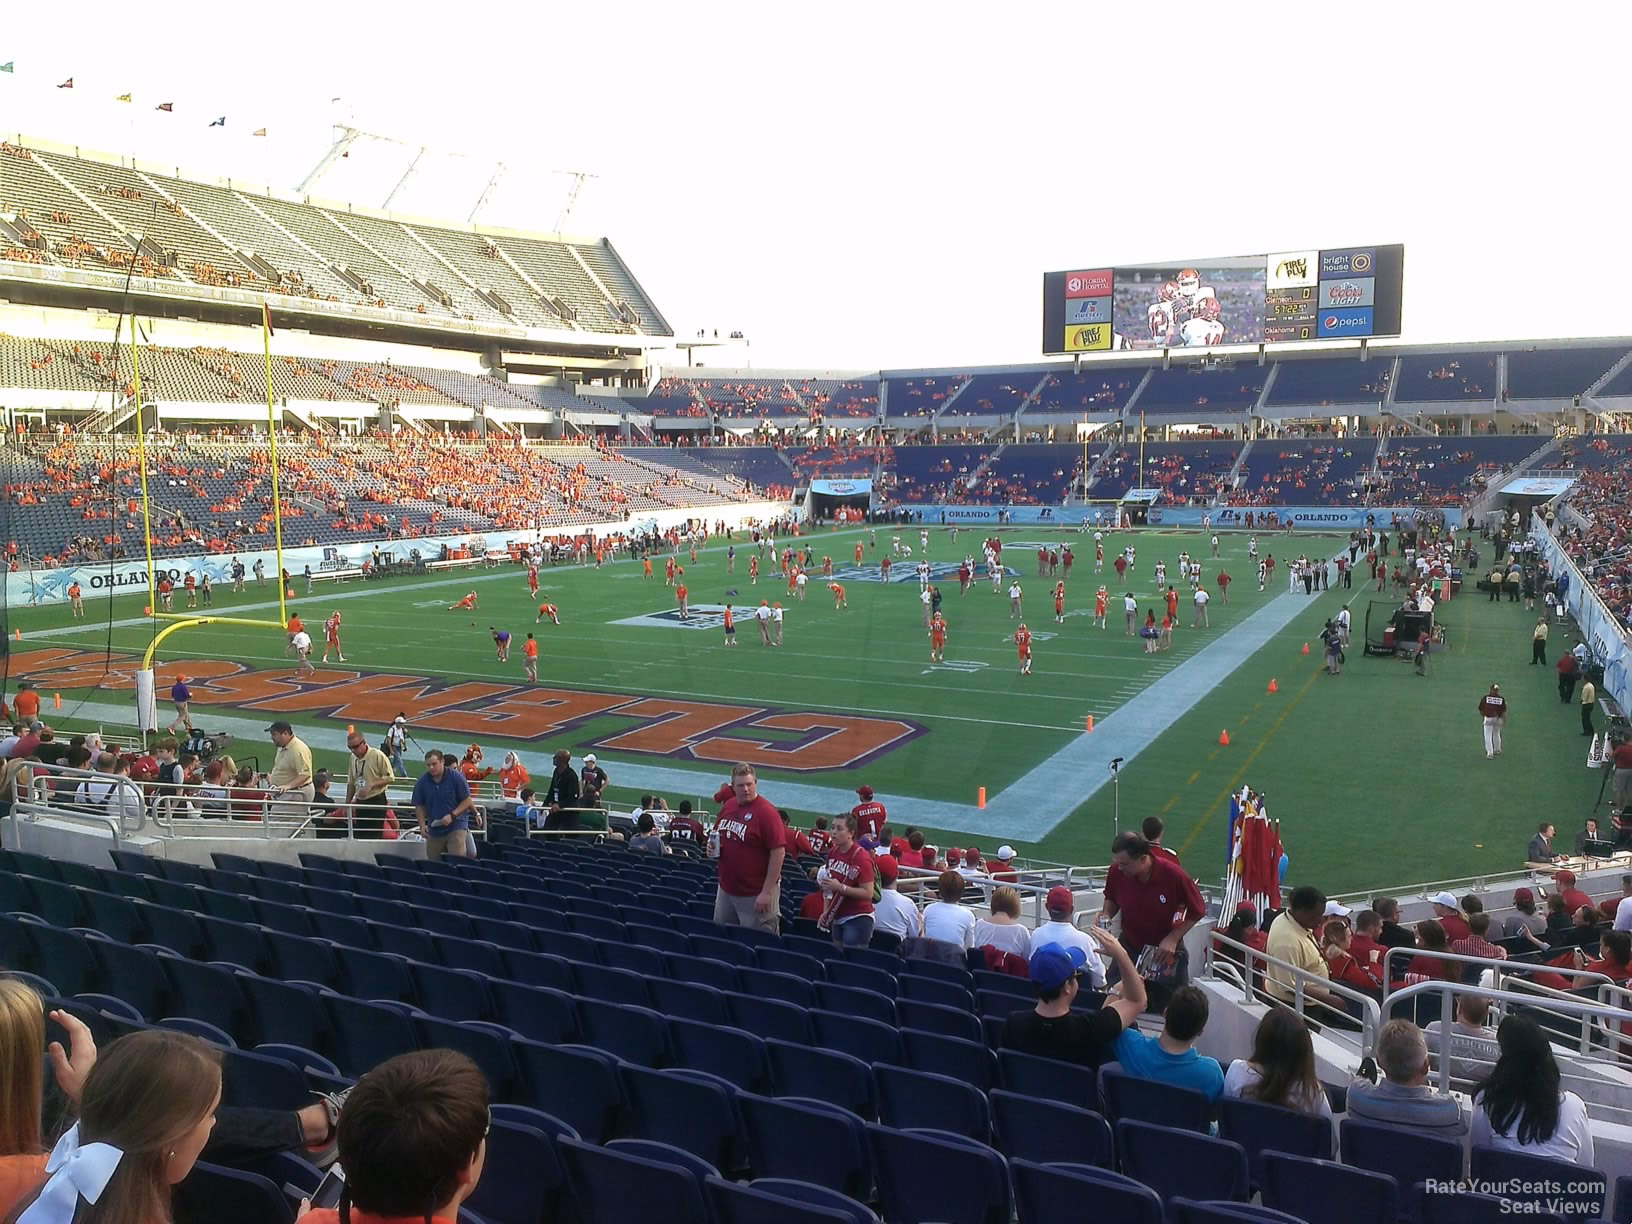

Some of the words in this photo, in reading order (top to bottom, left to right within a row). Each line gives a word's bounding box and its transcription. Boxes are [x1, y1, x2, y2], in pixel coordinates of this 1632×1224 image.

[1323, 256, 1349, 265] bright
[1323, 264, 1349, 273] house
[1330, 296, 1361, 305] LIGHT
[1339, 316, 1366, 327] pepsi
[1264, 327, 1295, 335] Oklahoma
[1294, 513, 1348, 521] ORLANDO
[869, 819, 878, 838] 1
